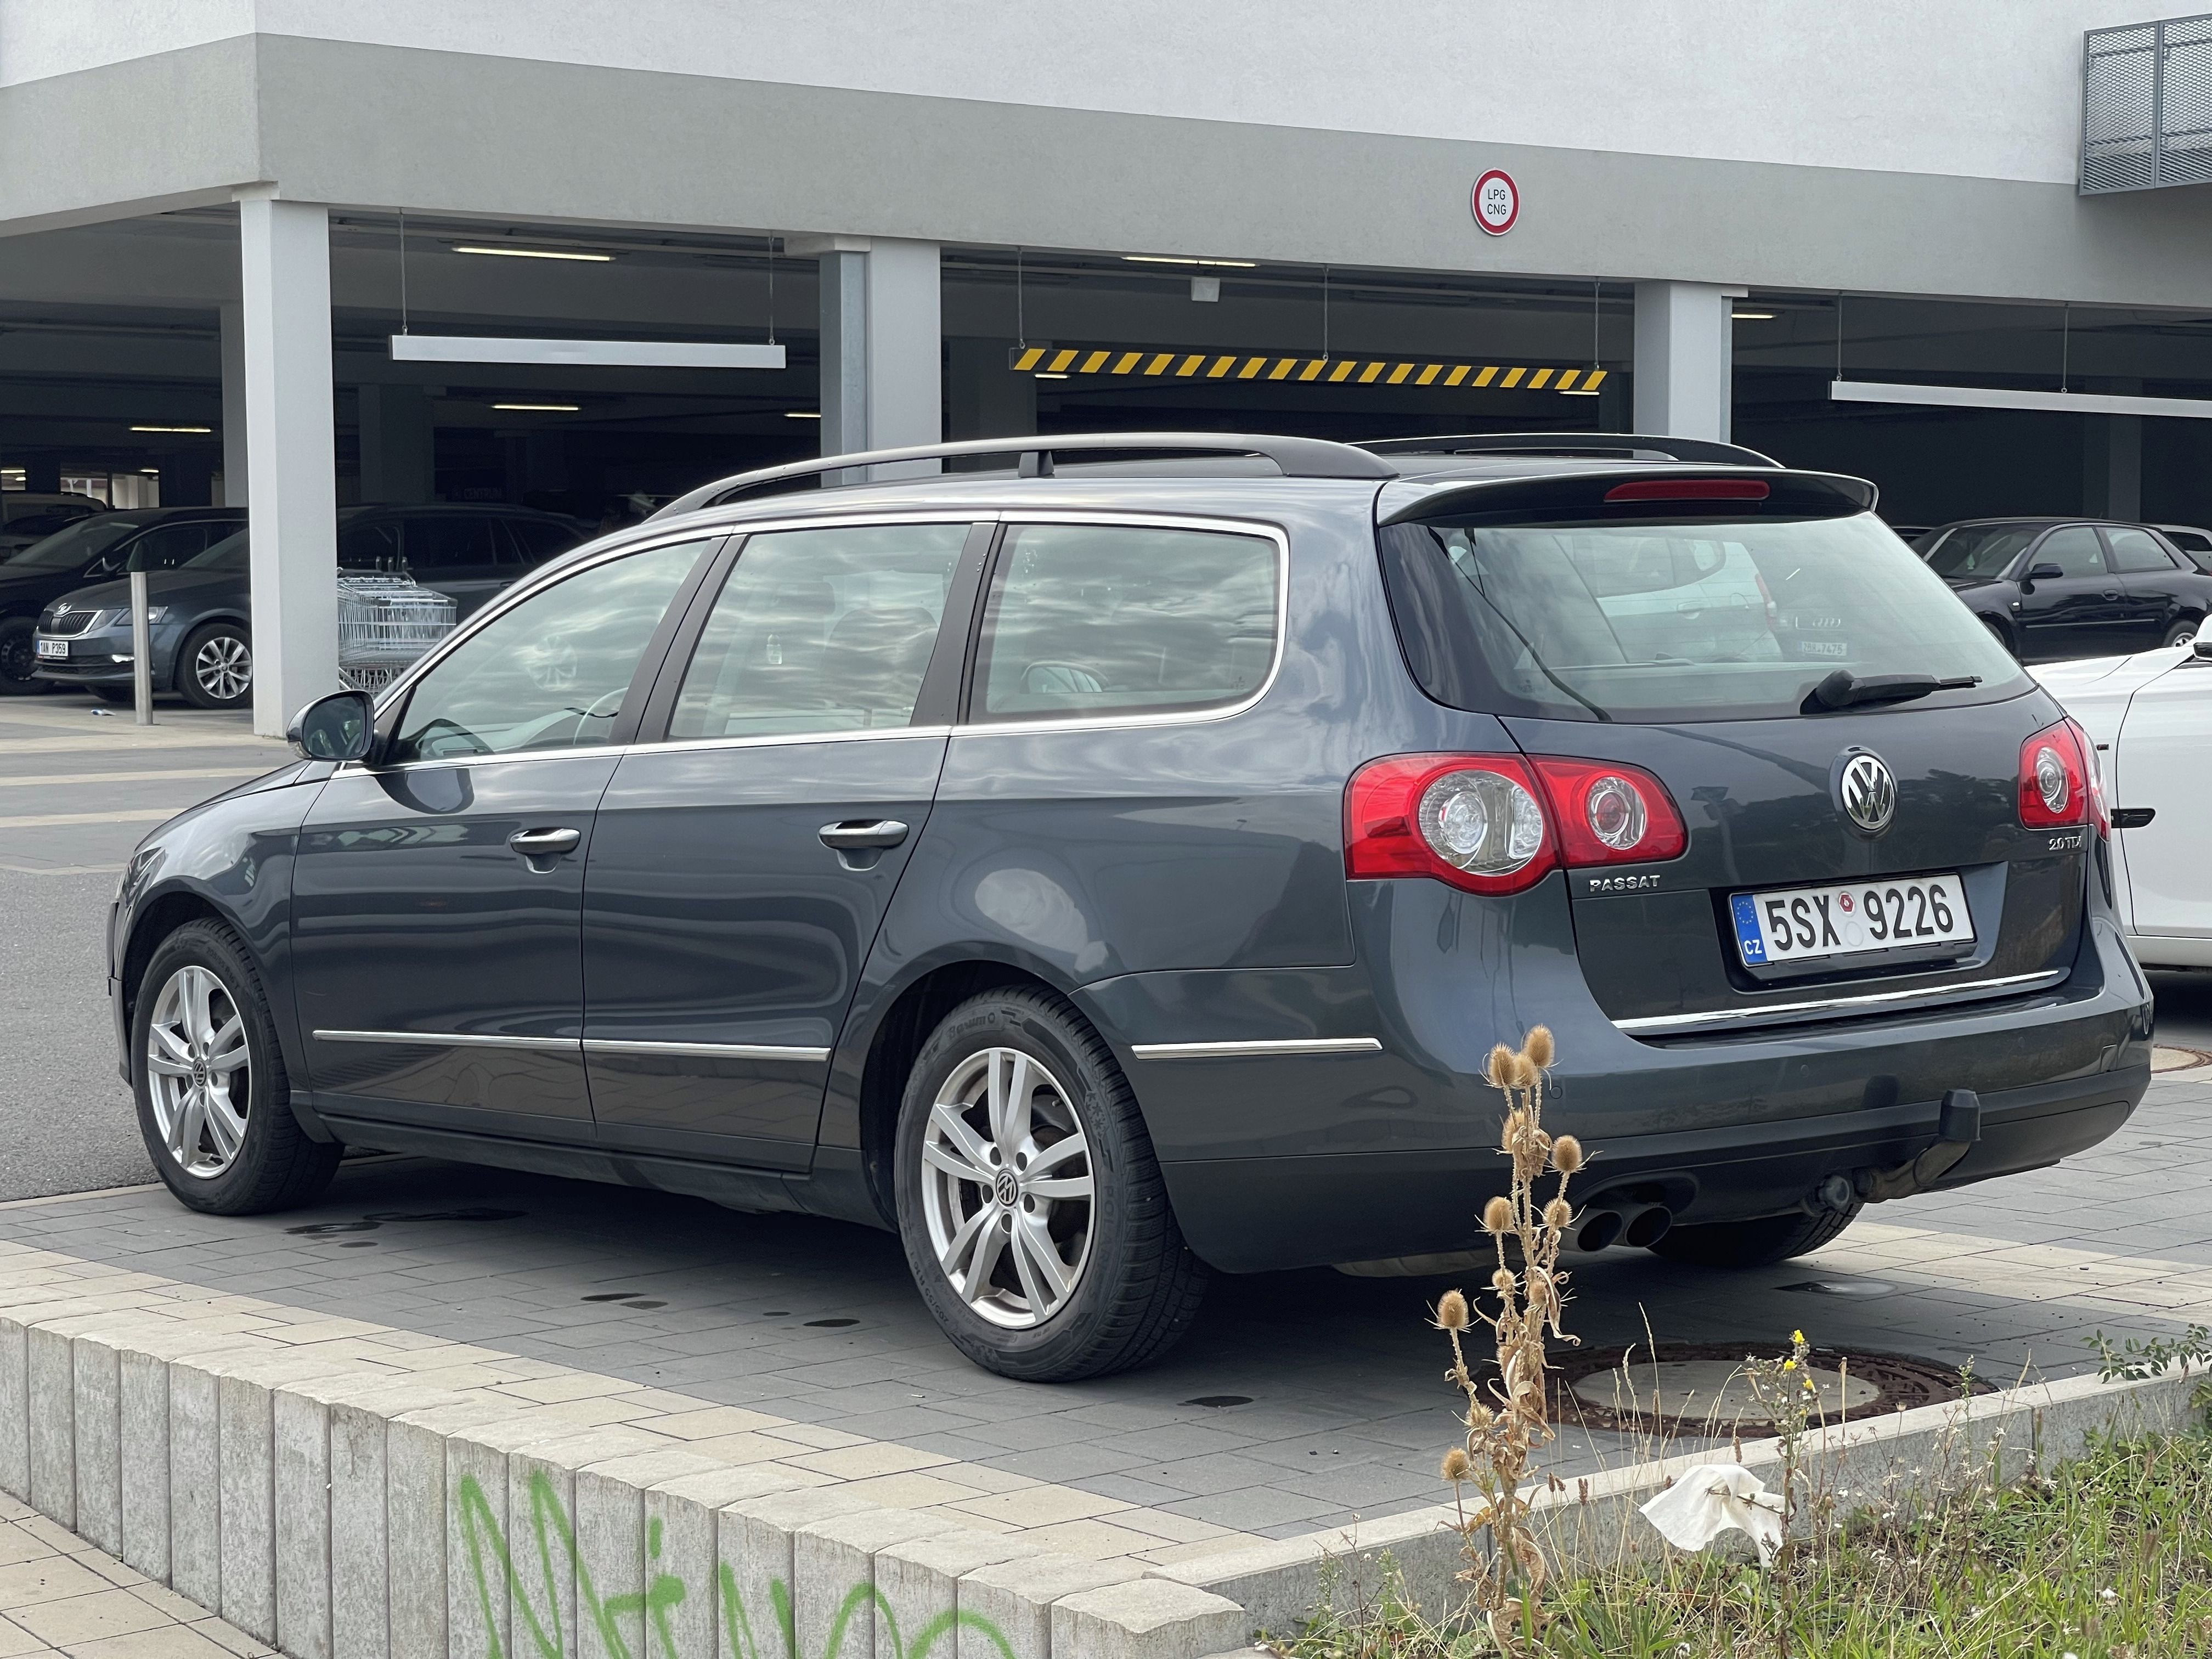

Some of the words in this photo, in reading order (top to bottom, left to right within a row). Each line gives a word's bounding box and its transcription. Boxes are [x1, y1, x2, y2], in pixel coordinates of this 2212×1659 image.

[1488, 189, 1505, 200] LPG
[1487, 204, 1506, 215] CNG
[52, 642, 66, 654] P359
[1821, 644, 1843, 654] 7475
[2064, 836, 2081, 849] TDI
[1589, 875, 1660, 892] PASSAT
[1765, 895, 1841, 951] 5SX
[1863, 884, 1953, 940] 9226
[1744, 939, 1762, 955] CZ
[945, 1015, 986, 1040] Barum
[925, 1287, 949, 1325] 205/55
